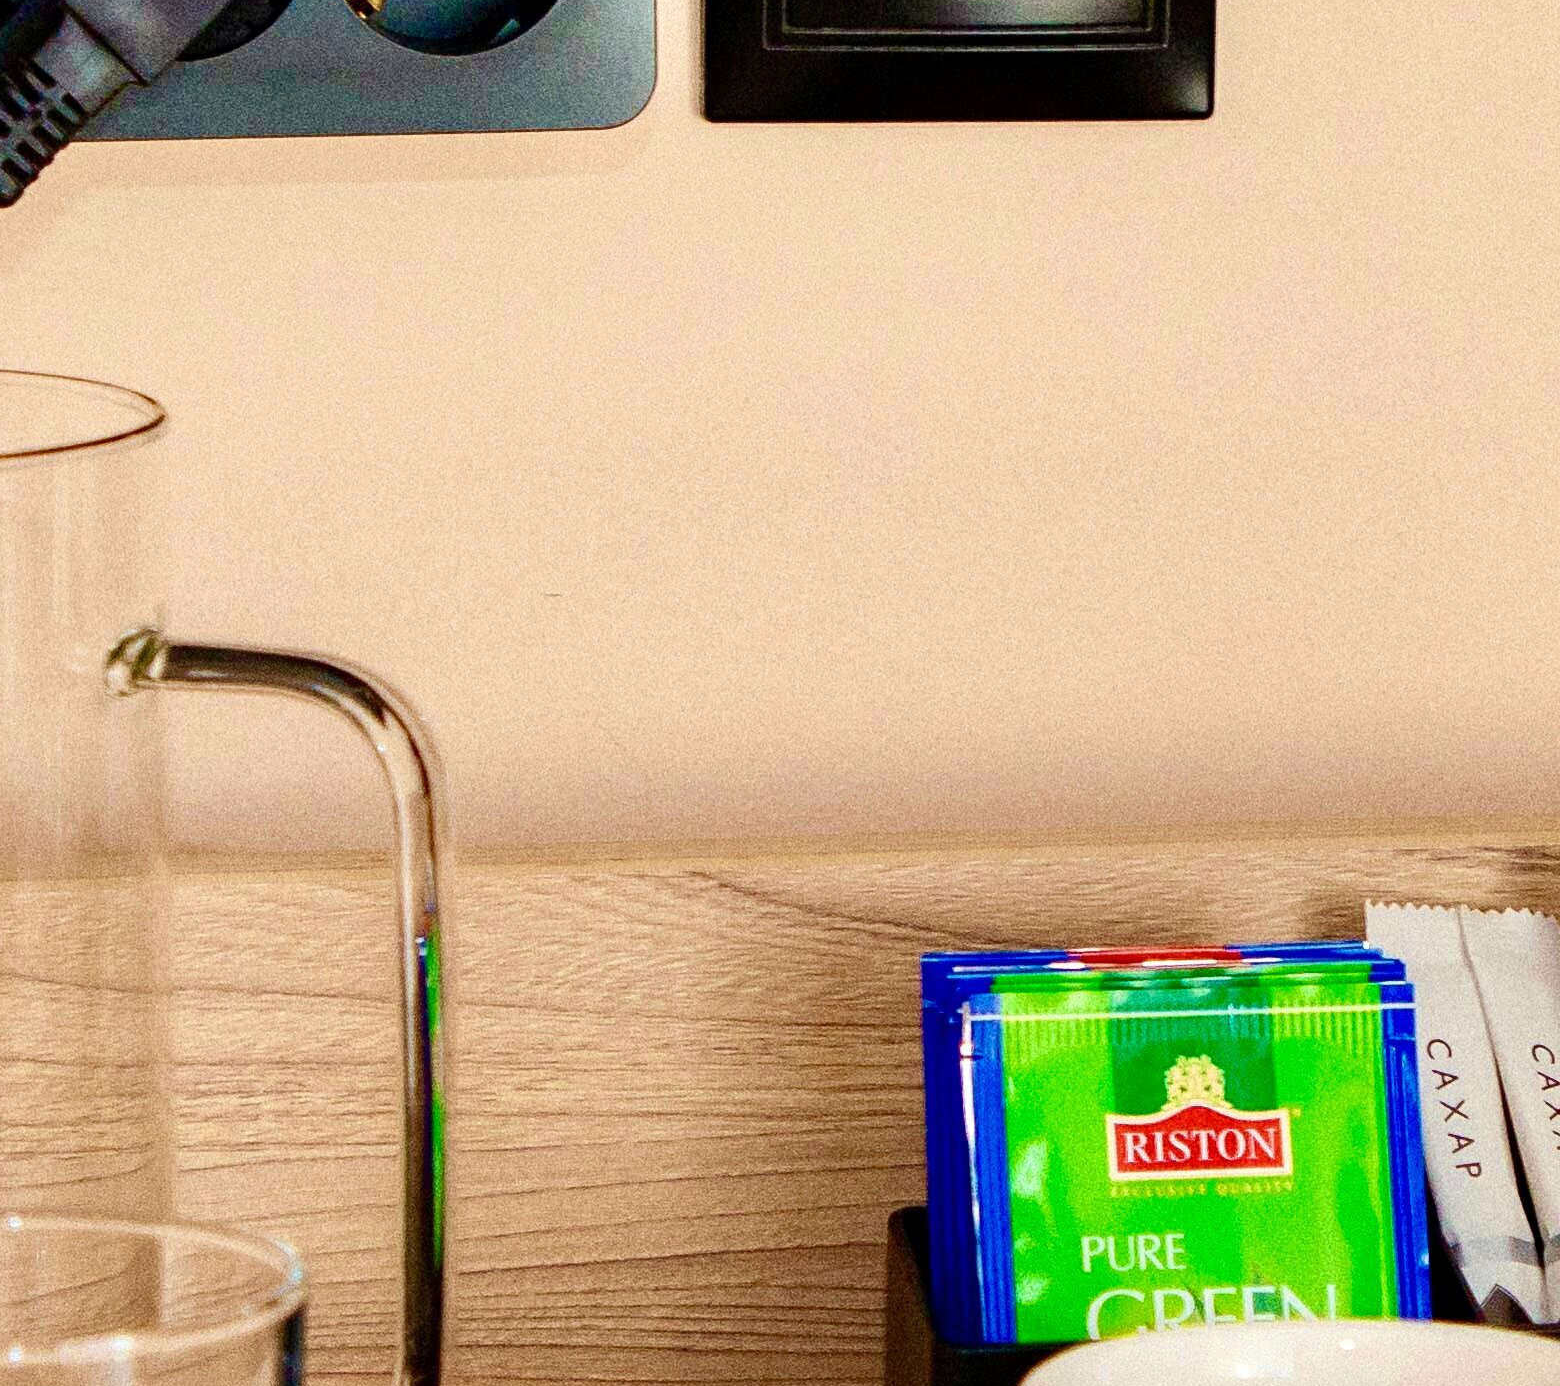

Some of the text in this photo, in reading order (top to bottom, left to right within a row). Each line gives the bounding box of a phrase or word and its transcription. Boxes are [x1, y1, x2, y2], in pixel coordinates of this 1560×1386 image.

[1426, 1038, 1482, 1178] САХАР
[1123, 1127, 1277, 1164] RISTON
[1081, 1232, 1187, 1273] PURE
[1086, 1283, 1337, 1341] GREEN
